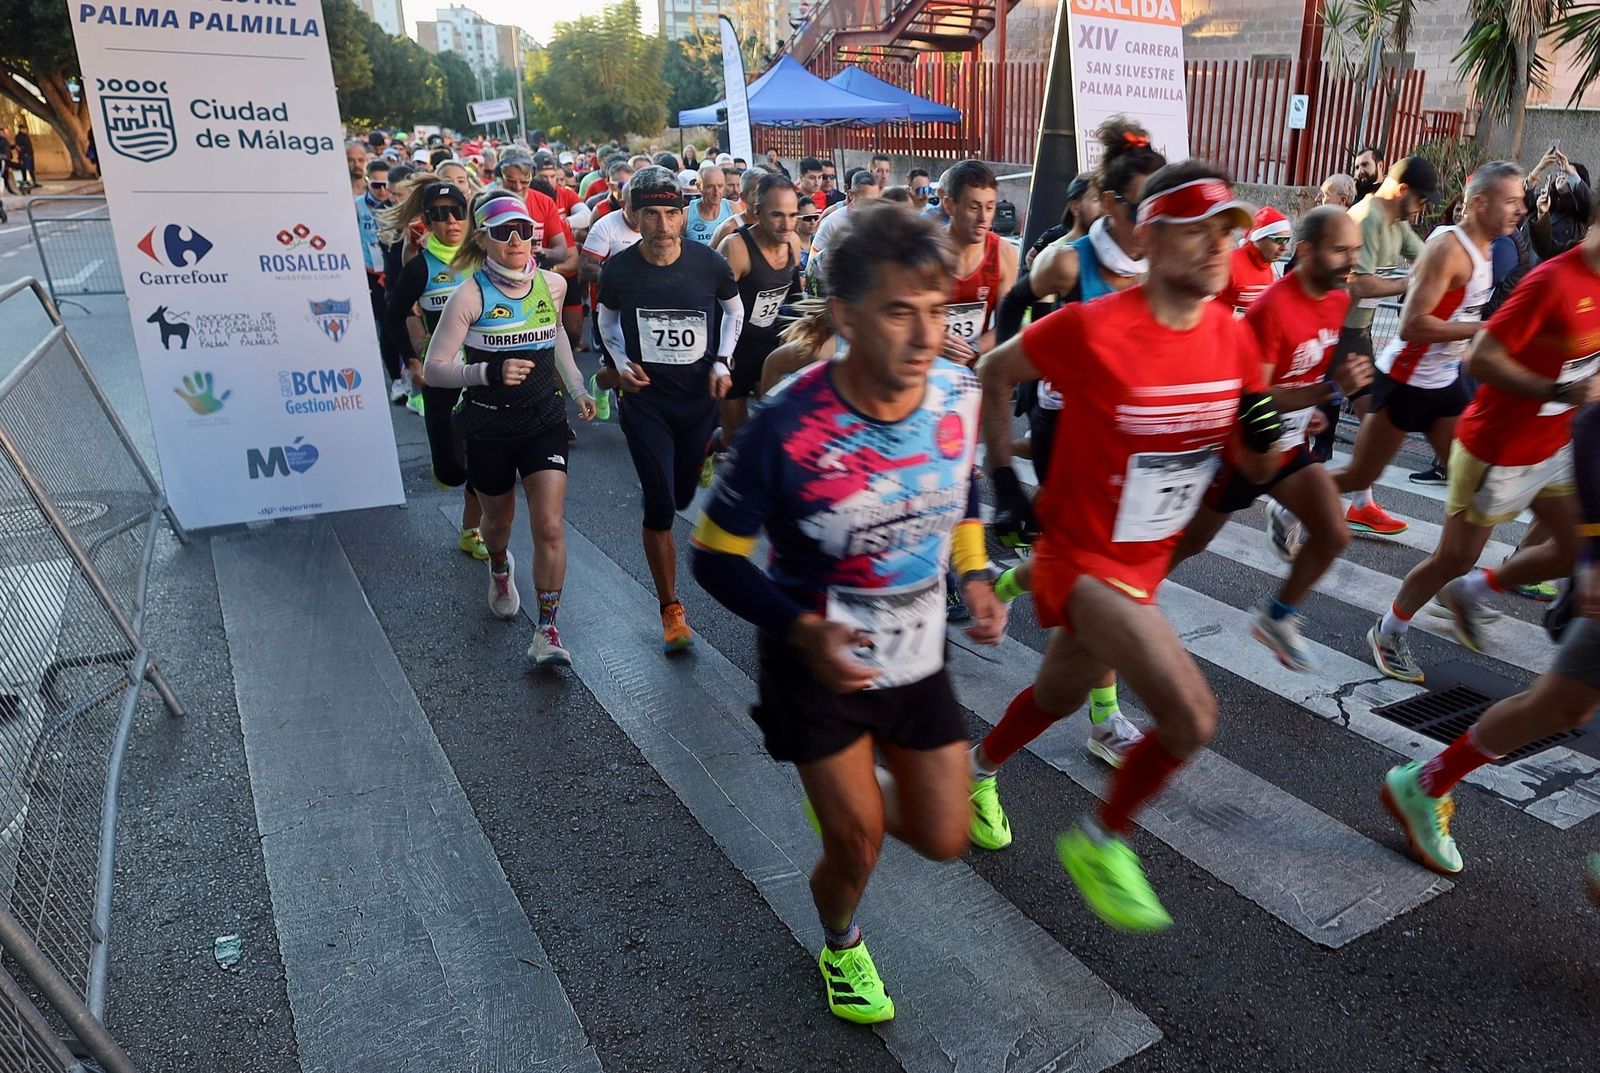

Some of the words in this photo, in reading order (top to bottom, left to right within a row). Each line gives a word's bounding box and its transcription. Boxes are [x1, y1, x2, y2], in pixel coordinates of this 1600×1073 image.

[80, 4, 179, 29] PALMA
[189, 11, 319, 37] PALMILLA
[1078, 24, 1119, 51] XIV
[1125, 41, 1178, 58] CARRERA
[1086, 61, 1111, 75] SAN
[1115, 64, 1175, 81] SILVESTRE
[1079, 81, 1122, 96] PALMA
[1126, 85, 1184, 101] PALMILLA
[190, 99, 288, 122] Ciudad
[196, 129, 230, 148] de
[238, 129, 334, 155] Málaga
[259, 253, 351, 273] ROSALEDA
[140, 270, 229, 286] Carrefour
[482, 328, 556, 345] TORREMOLINOS
[652, 329, 695, 347] 750
[292, 368, 338, 396] BCM
[285, 395, 364, 415] GestionARTE
